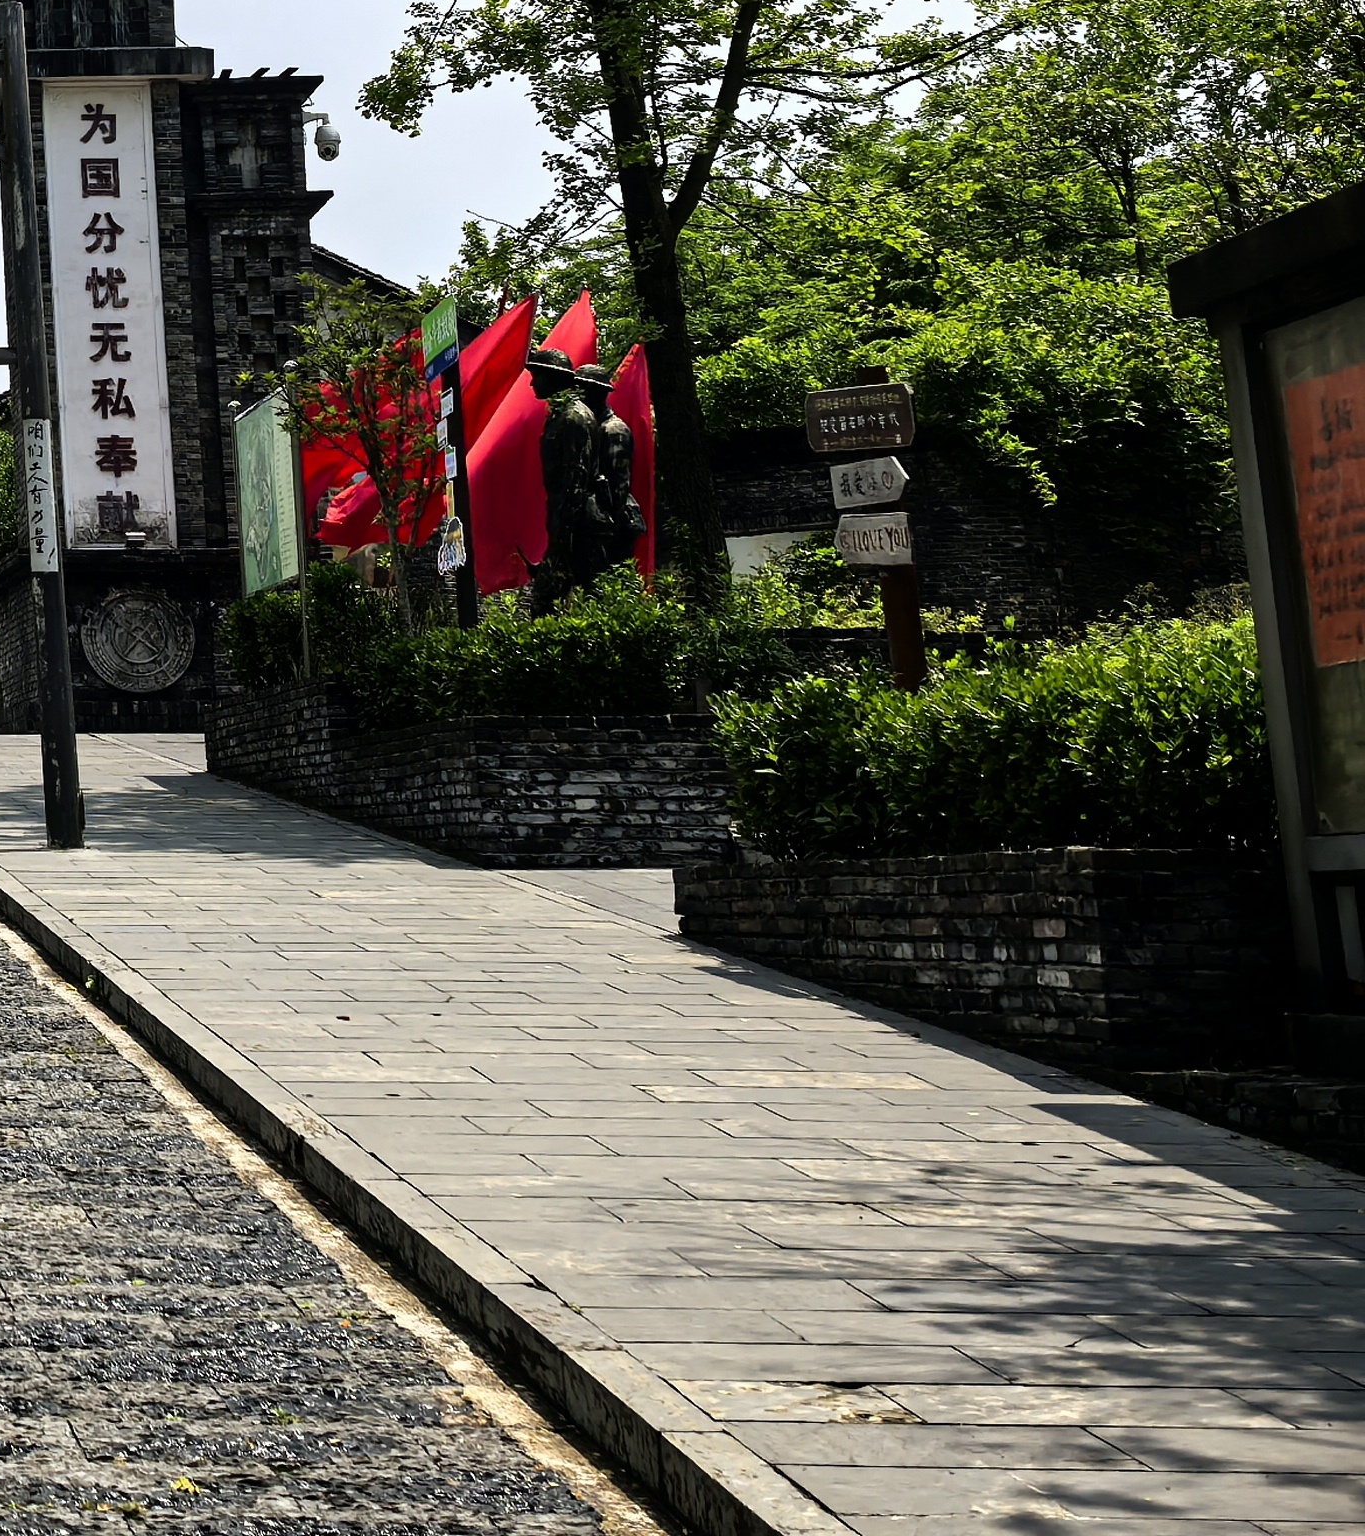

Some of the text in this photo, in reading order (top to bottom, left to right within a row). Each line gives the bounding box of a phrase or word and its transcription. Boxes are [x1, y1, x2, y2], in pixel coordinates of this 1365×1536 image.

[79, 103, 140, 535] 为国分忧无私奉献
[884, 526, 909, 552] YOU
